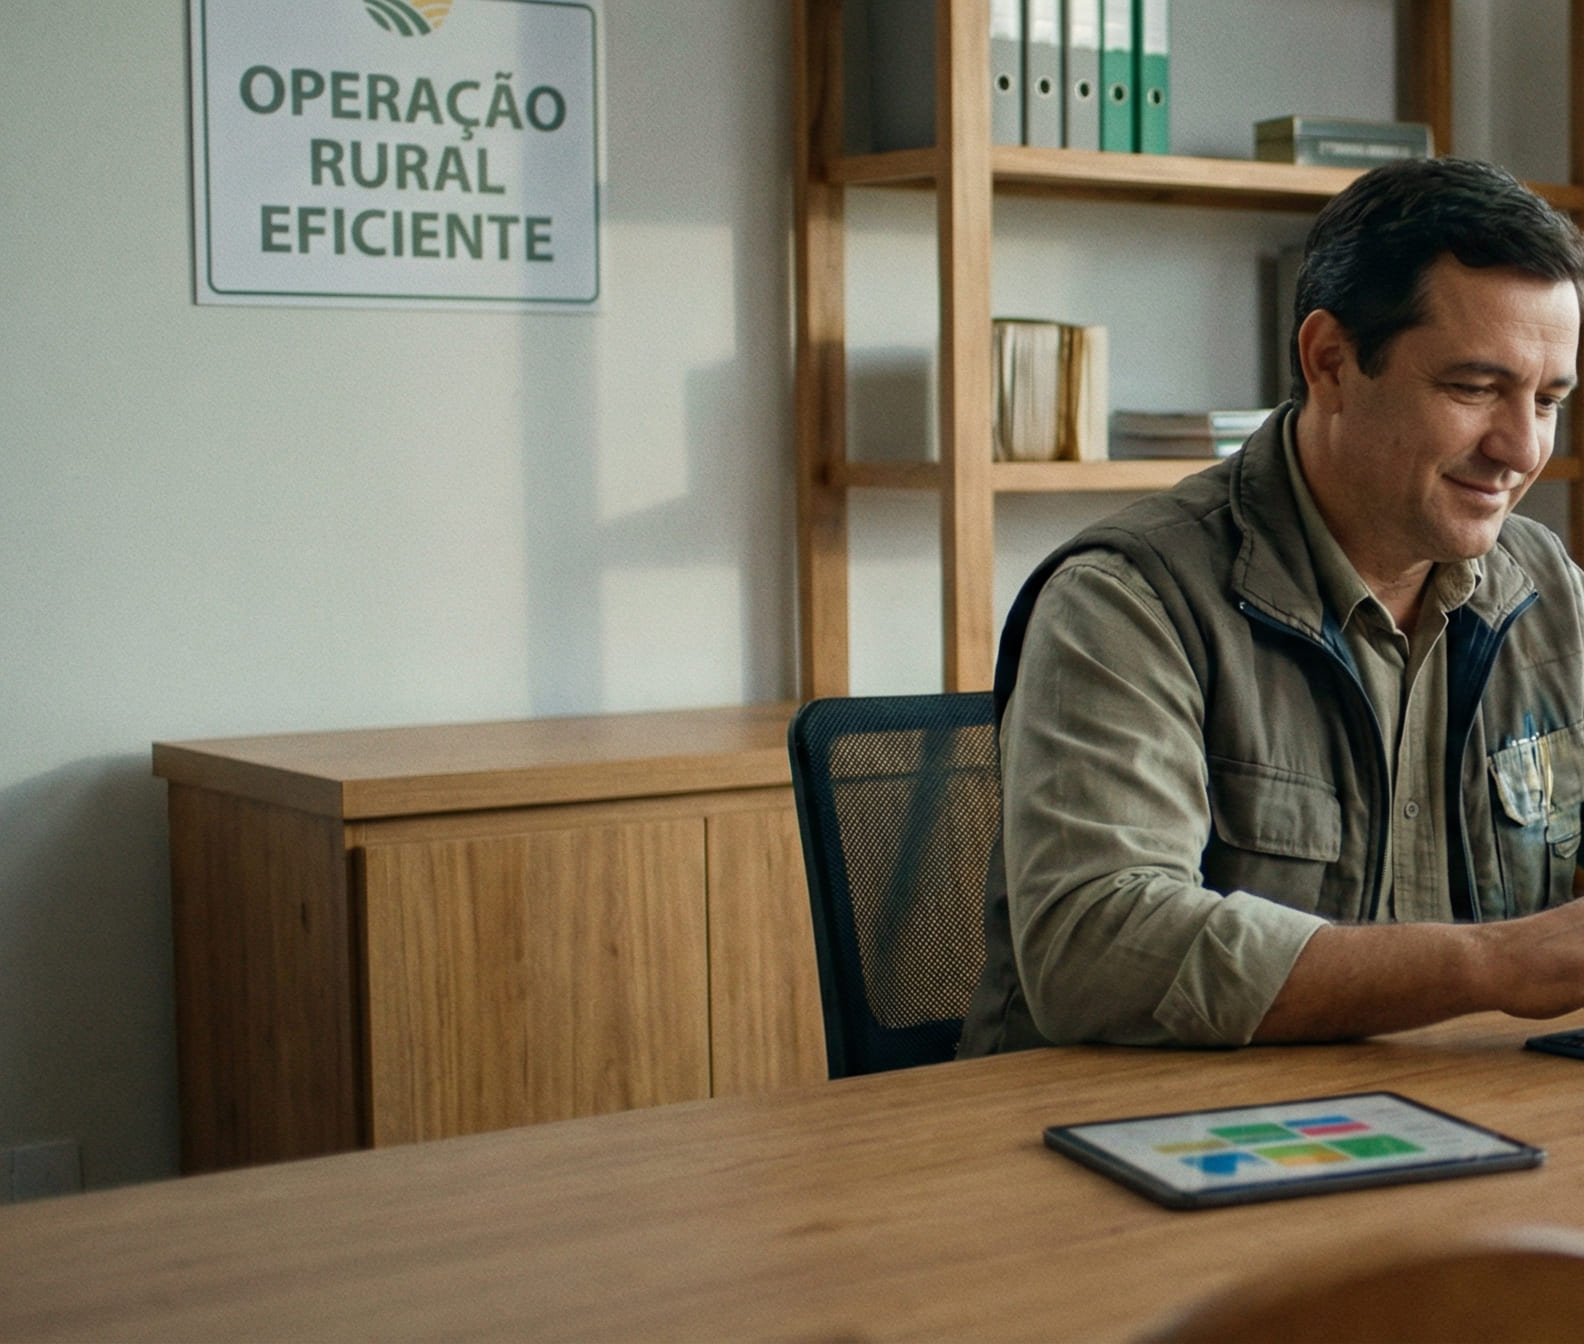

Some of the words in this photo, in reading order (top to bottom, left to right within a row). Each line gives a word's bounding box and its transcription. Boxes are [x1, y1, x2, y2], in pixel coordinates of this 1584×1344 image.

[239, 65, 566, 140] OPERAÇÃO
[310, 138, 505, 194] RURAL
[261, 205, 554, 262] EFICIENTE
